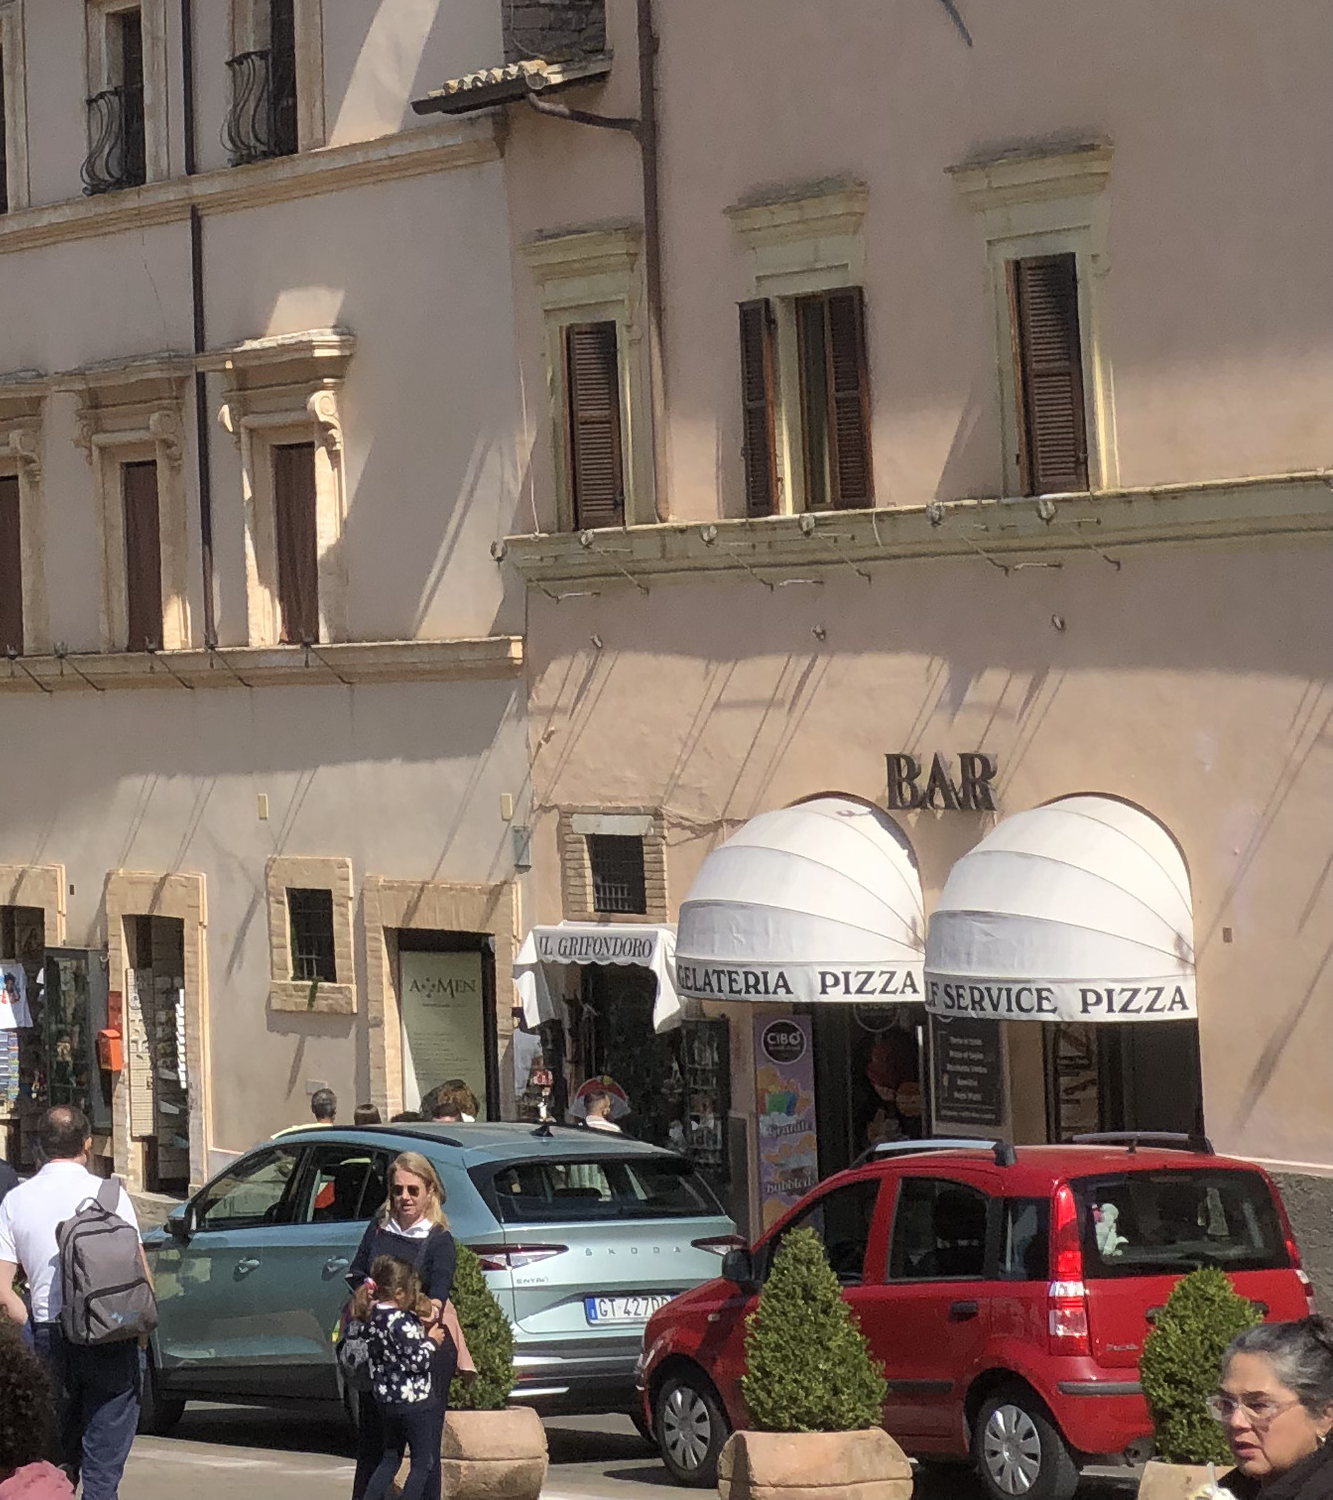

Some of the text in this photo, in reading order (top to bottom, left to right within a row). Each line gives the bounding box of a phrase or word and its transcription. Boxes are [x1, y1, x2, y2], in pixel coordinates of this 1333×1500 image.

[885, 752, 998, 811] BAR
[538, 935, 653, 958] IL GRIFONDORO
[678, 964, 920, 996] GELATERIA PIZZA
[943, 983, 1058, 1015] SERVICE
[1079, 985, 1190, 1015] PIZZA
[599, 1298, 616, 1317] GT
